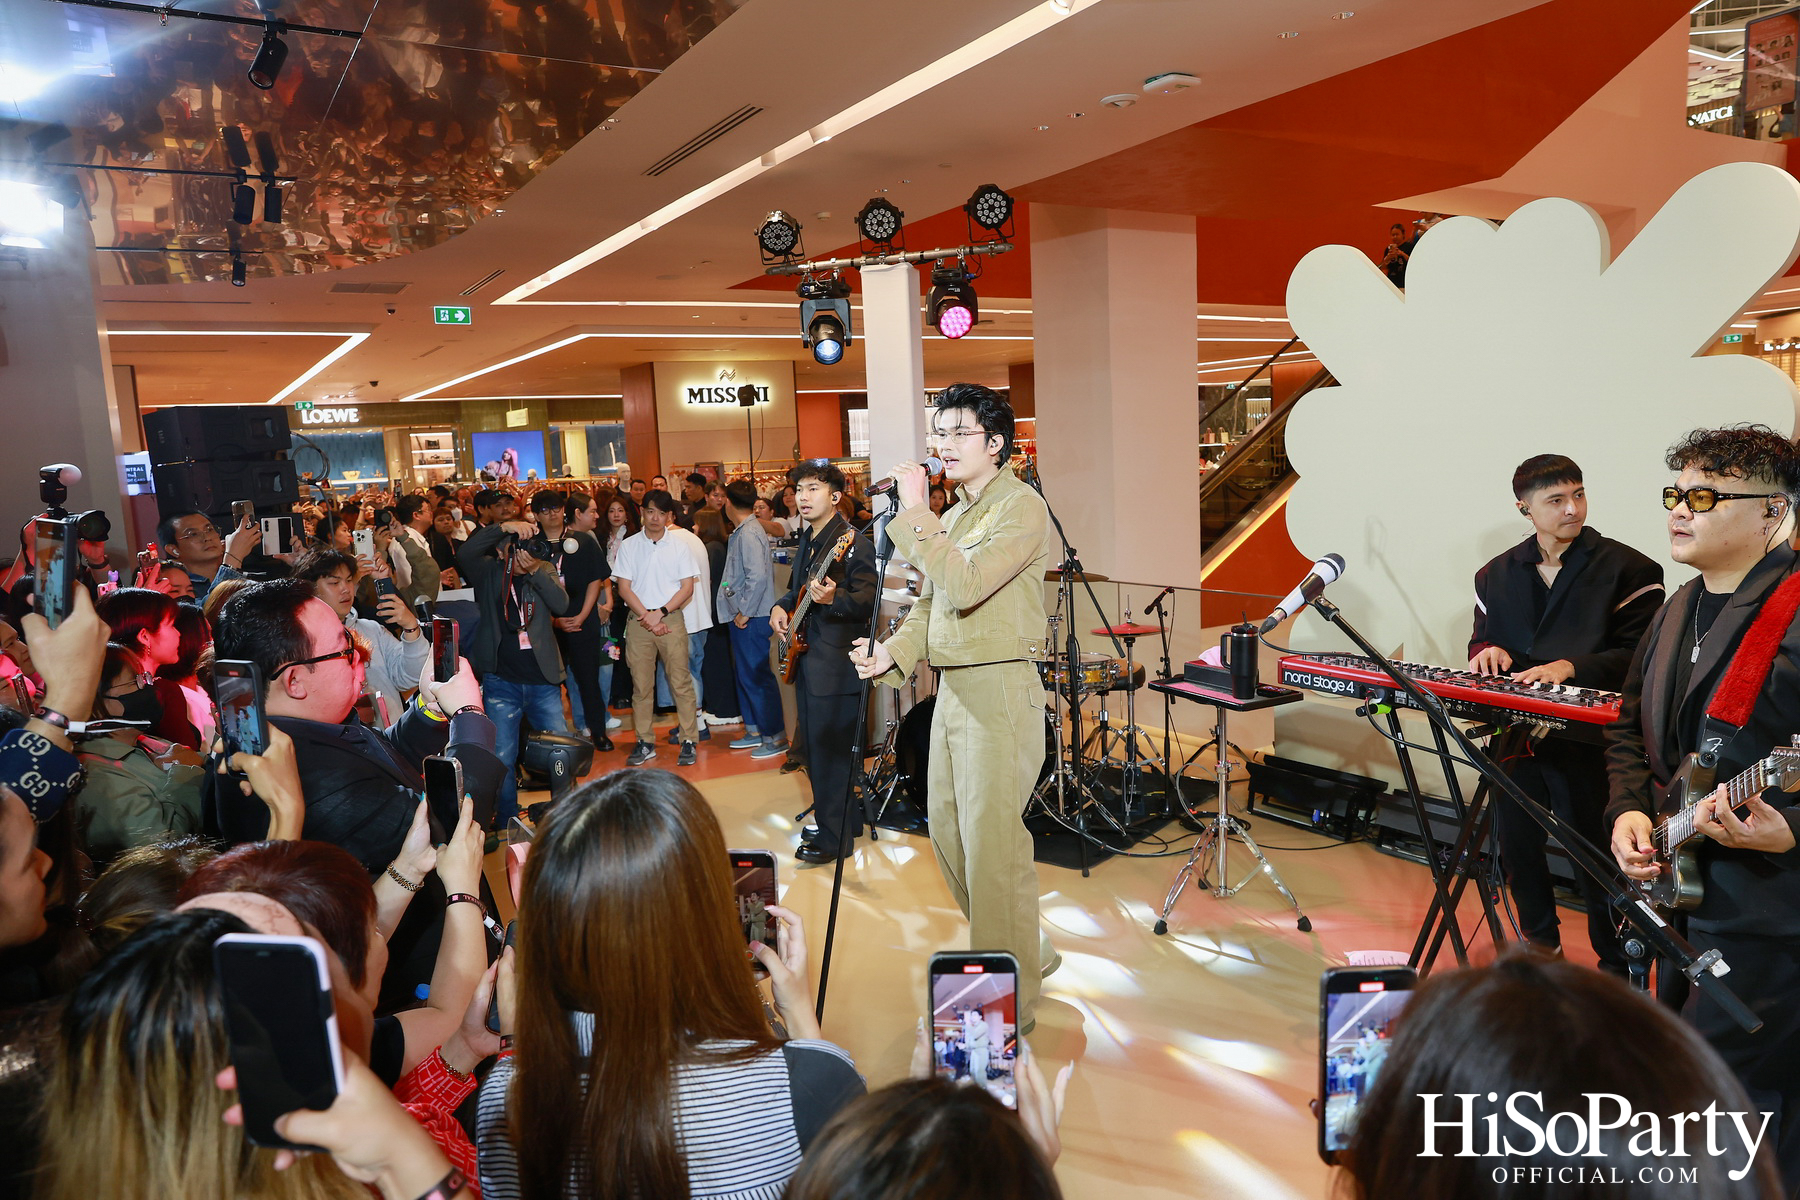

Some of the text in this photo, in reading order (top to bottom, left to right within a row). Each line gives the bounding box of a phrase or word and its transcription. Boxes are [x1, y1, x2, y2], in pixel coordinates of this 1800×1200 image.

[687, 386, 770, 404] MISSNI
[301, 407, 360, 424] LOEWE
[1284, 671, 1355, 694] nord stage 4
